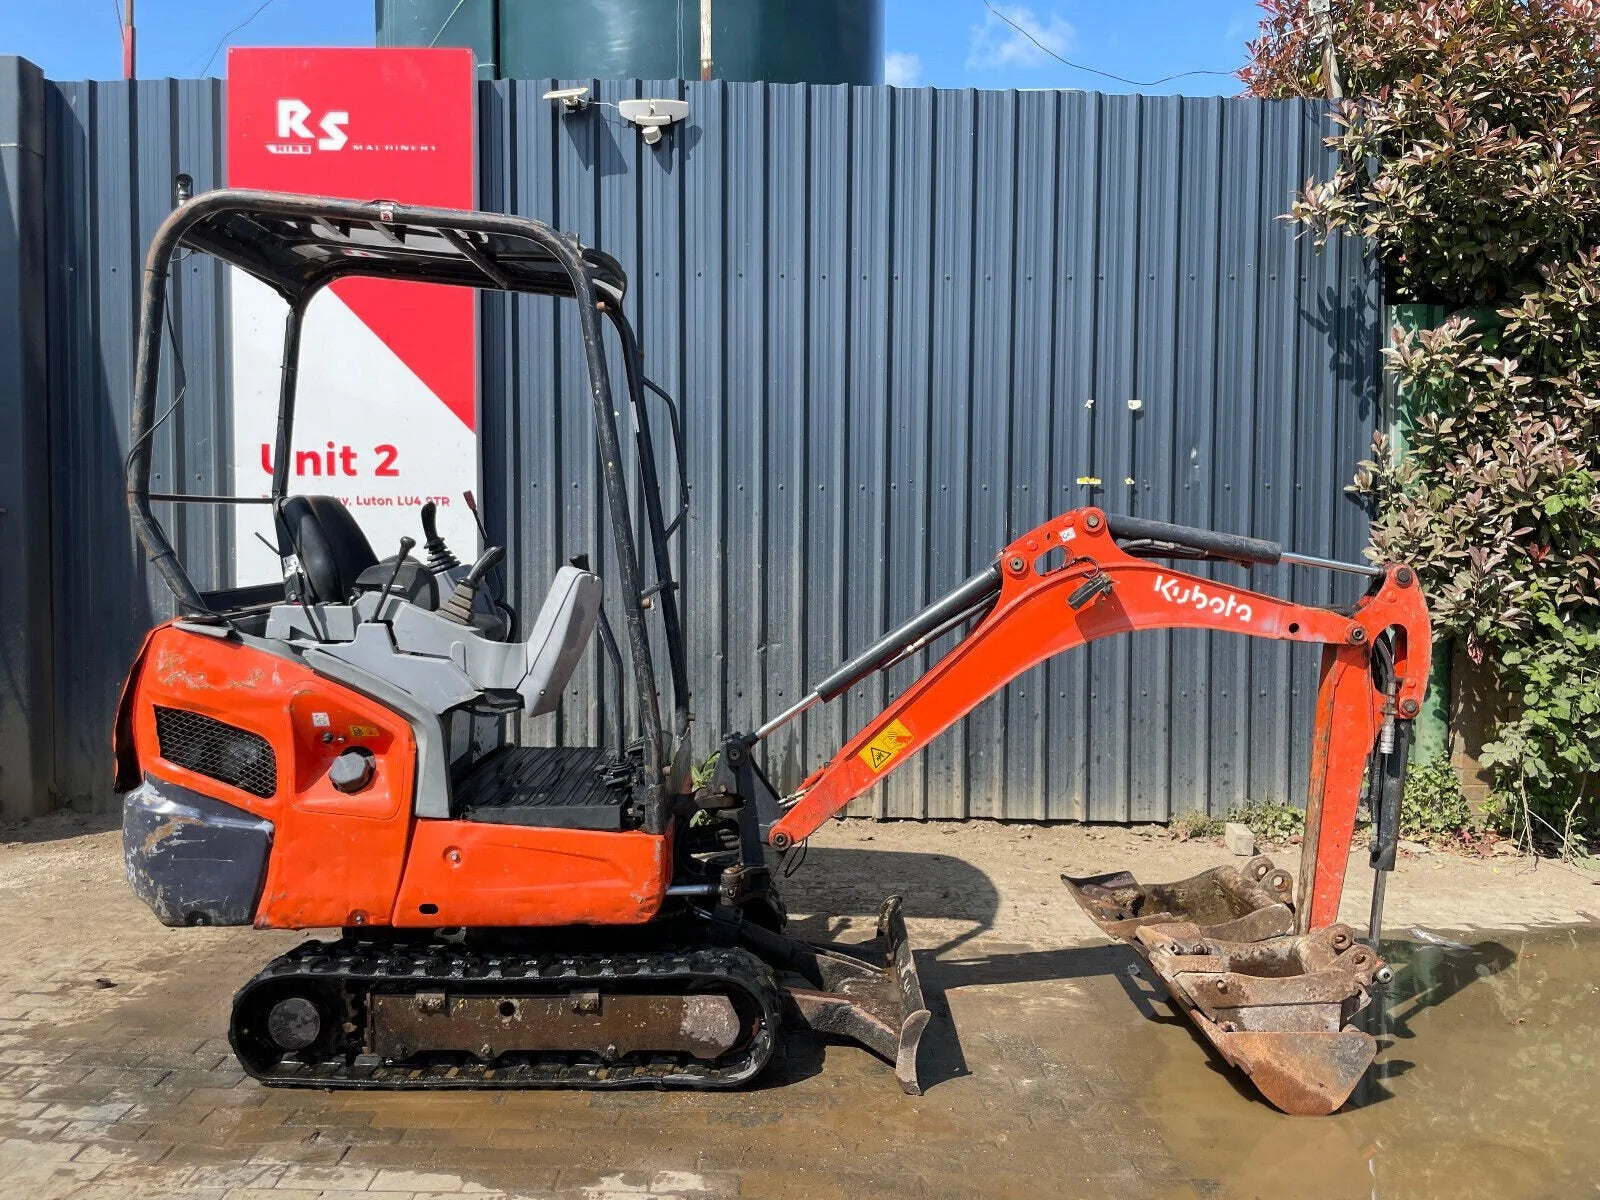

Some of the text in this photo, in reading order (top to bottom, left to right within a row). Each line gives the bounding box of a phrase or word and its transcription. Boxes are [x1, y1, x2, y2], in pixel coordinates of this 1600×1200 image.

[277, 99, 349, 151] RS
[374, 444, 400, 477] 2
[356, 495, 396, 506] Luton
[397, 496, 421, 506] LU4
[1153, 575, 1253, 623] Kubota
